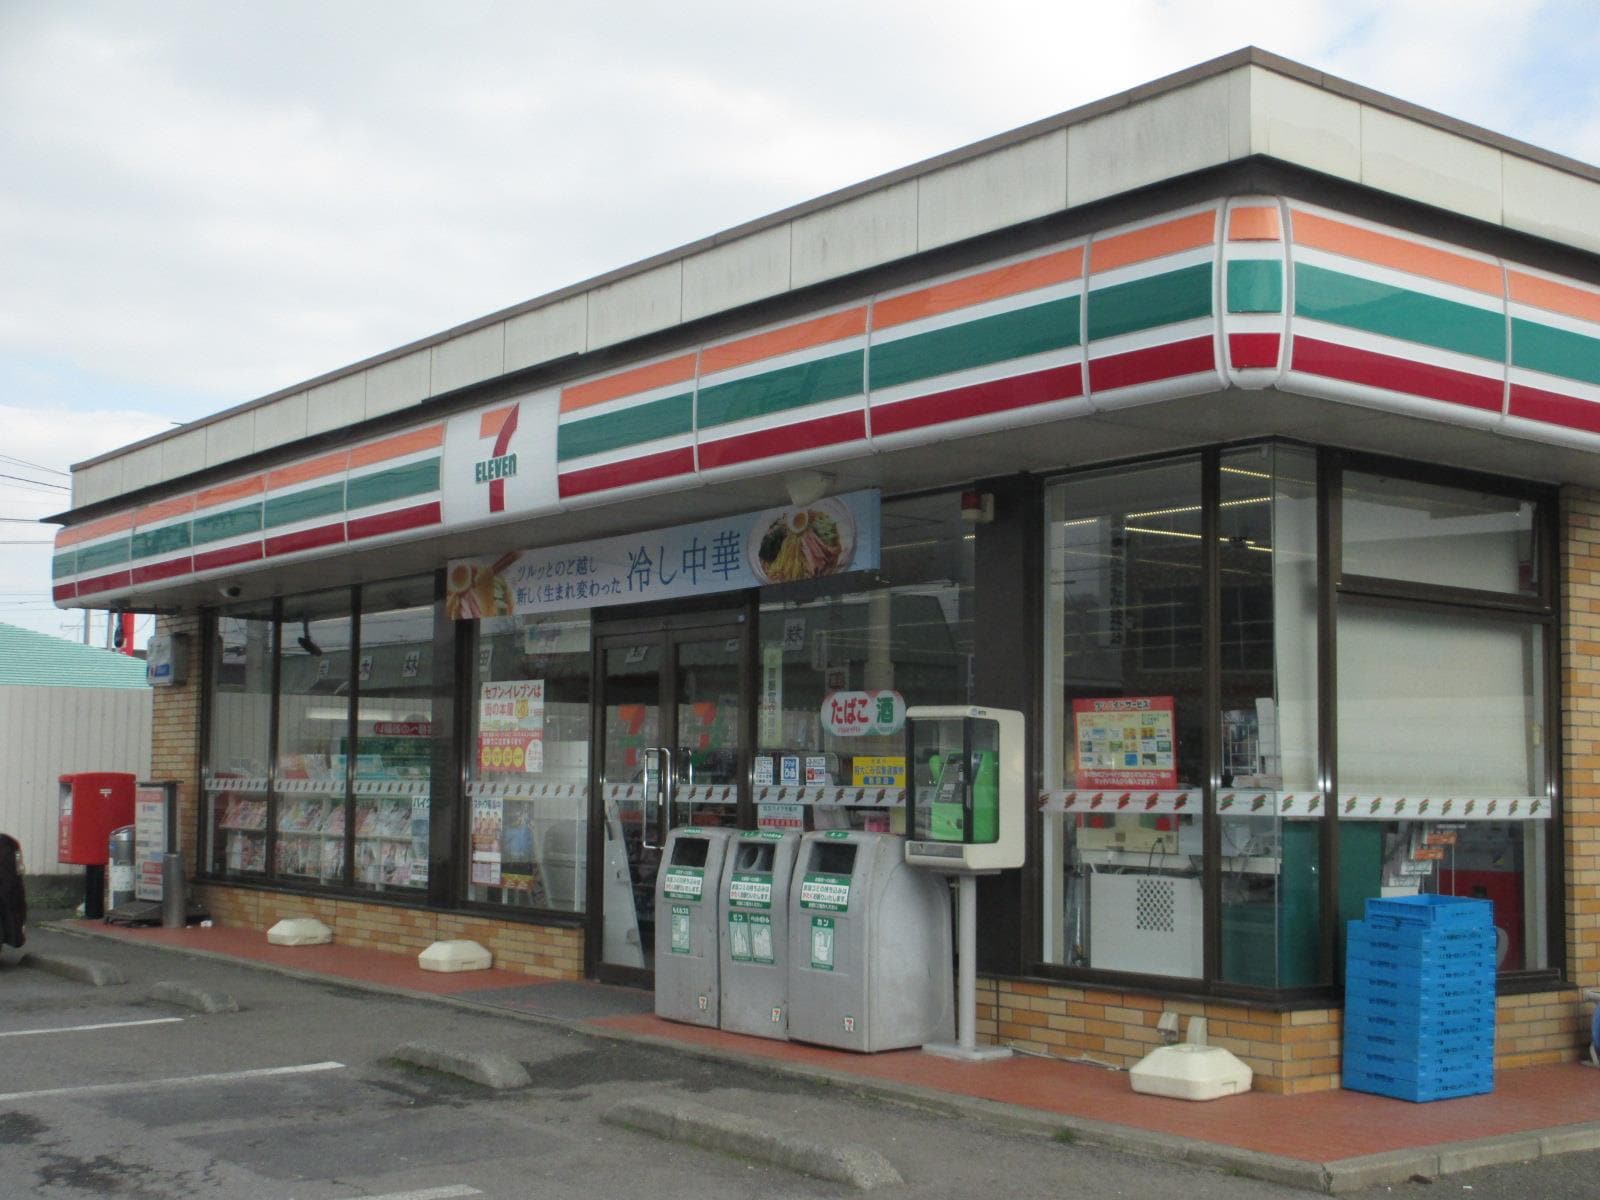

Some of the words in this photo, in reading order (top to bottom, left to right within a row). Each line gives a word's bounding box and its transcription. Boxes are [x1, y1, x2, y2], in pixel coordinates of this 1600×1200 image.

[479, 402, 520, 513] 7
[517, 556, 597, 580] ツルッとのど越し
[627, 530, 741, 592] 冷し中華
[516, 577, 622, 605] 新しく生まれ変わった
[831, 697, 869, 724] たばこ
[876, 696, 894, 723] 酒
[816, 919, 829, 927] カン
